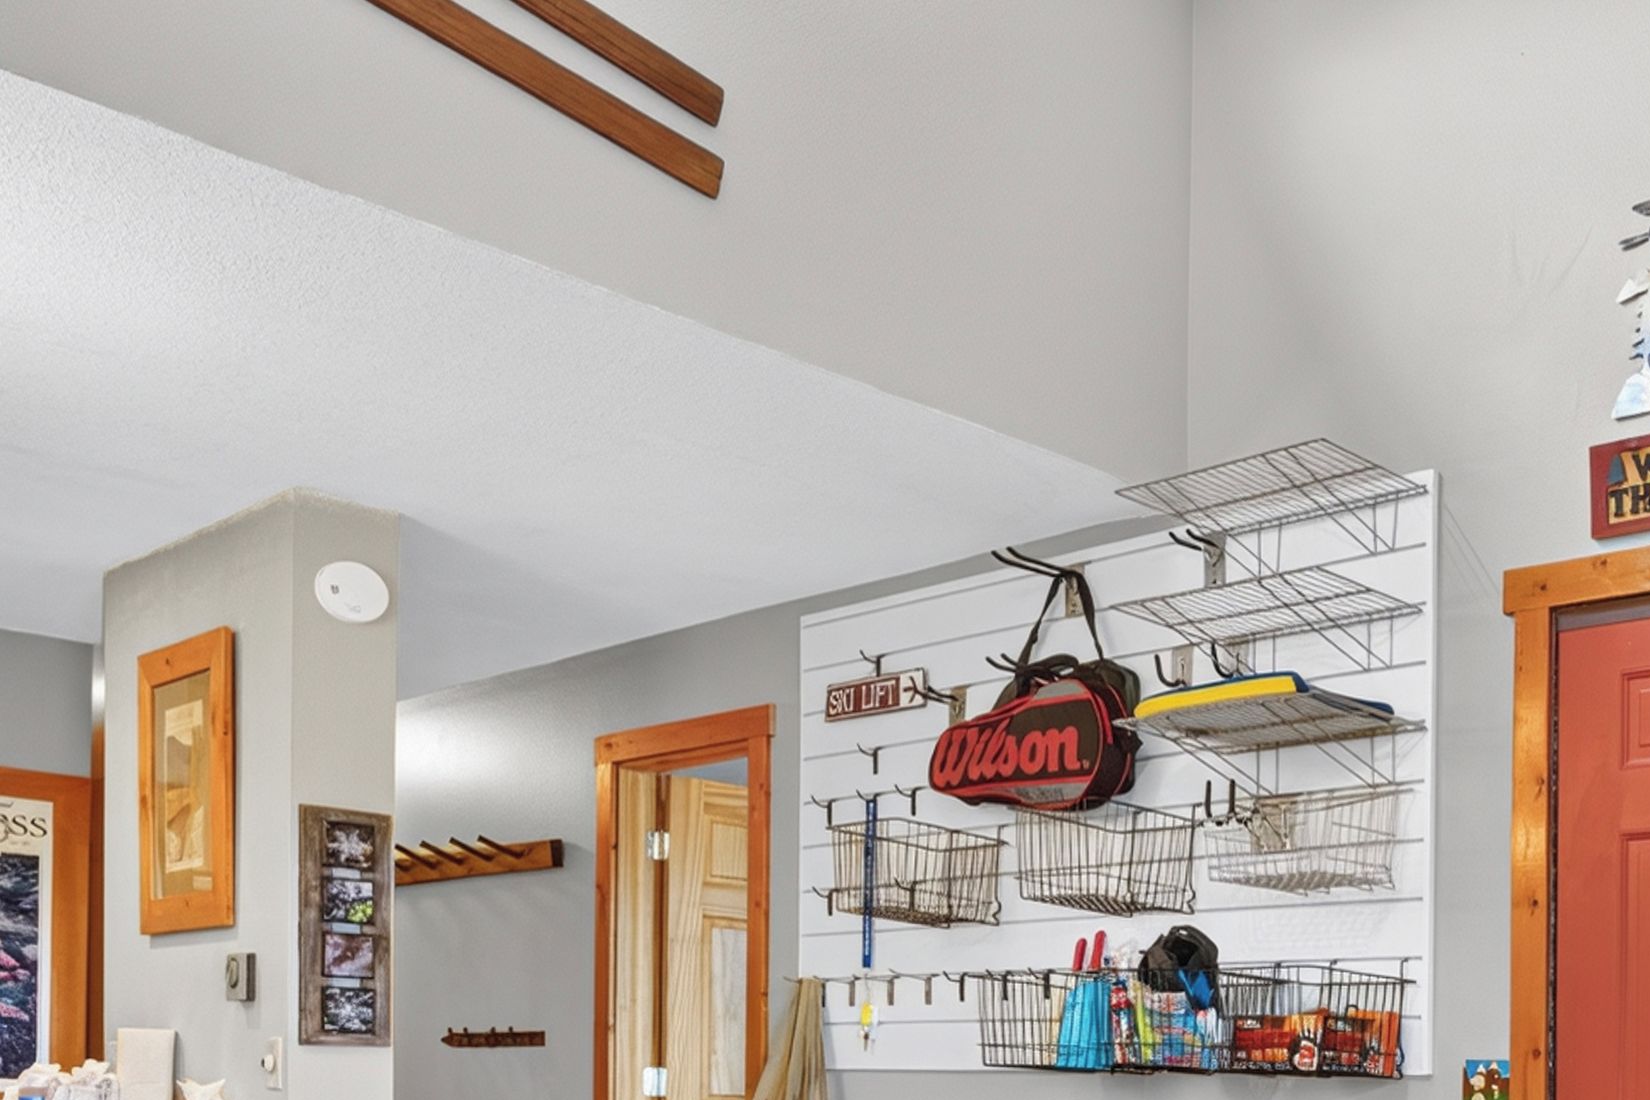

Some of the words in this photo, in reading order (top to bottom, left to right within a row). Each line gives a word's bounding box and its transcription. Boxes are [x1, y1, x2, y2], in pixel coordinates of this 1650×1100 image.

[829, 687, 855, 716] SKI
[861, 680, 897, 710] LIFT
[931, 717, 1082, 789] Wilson
